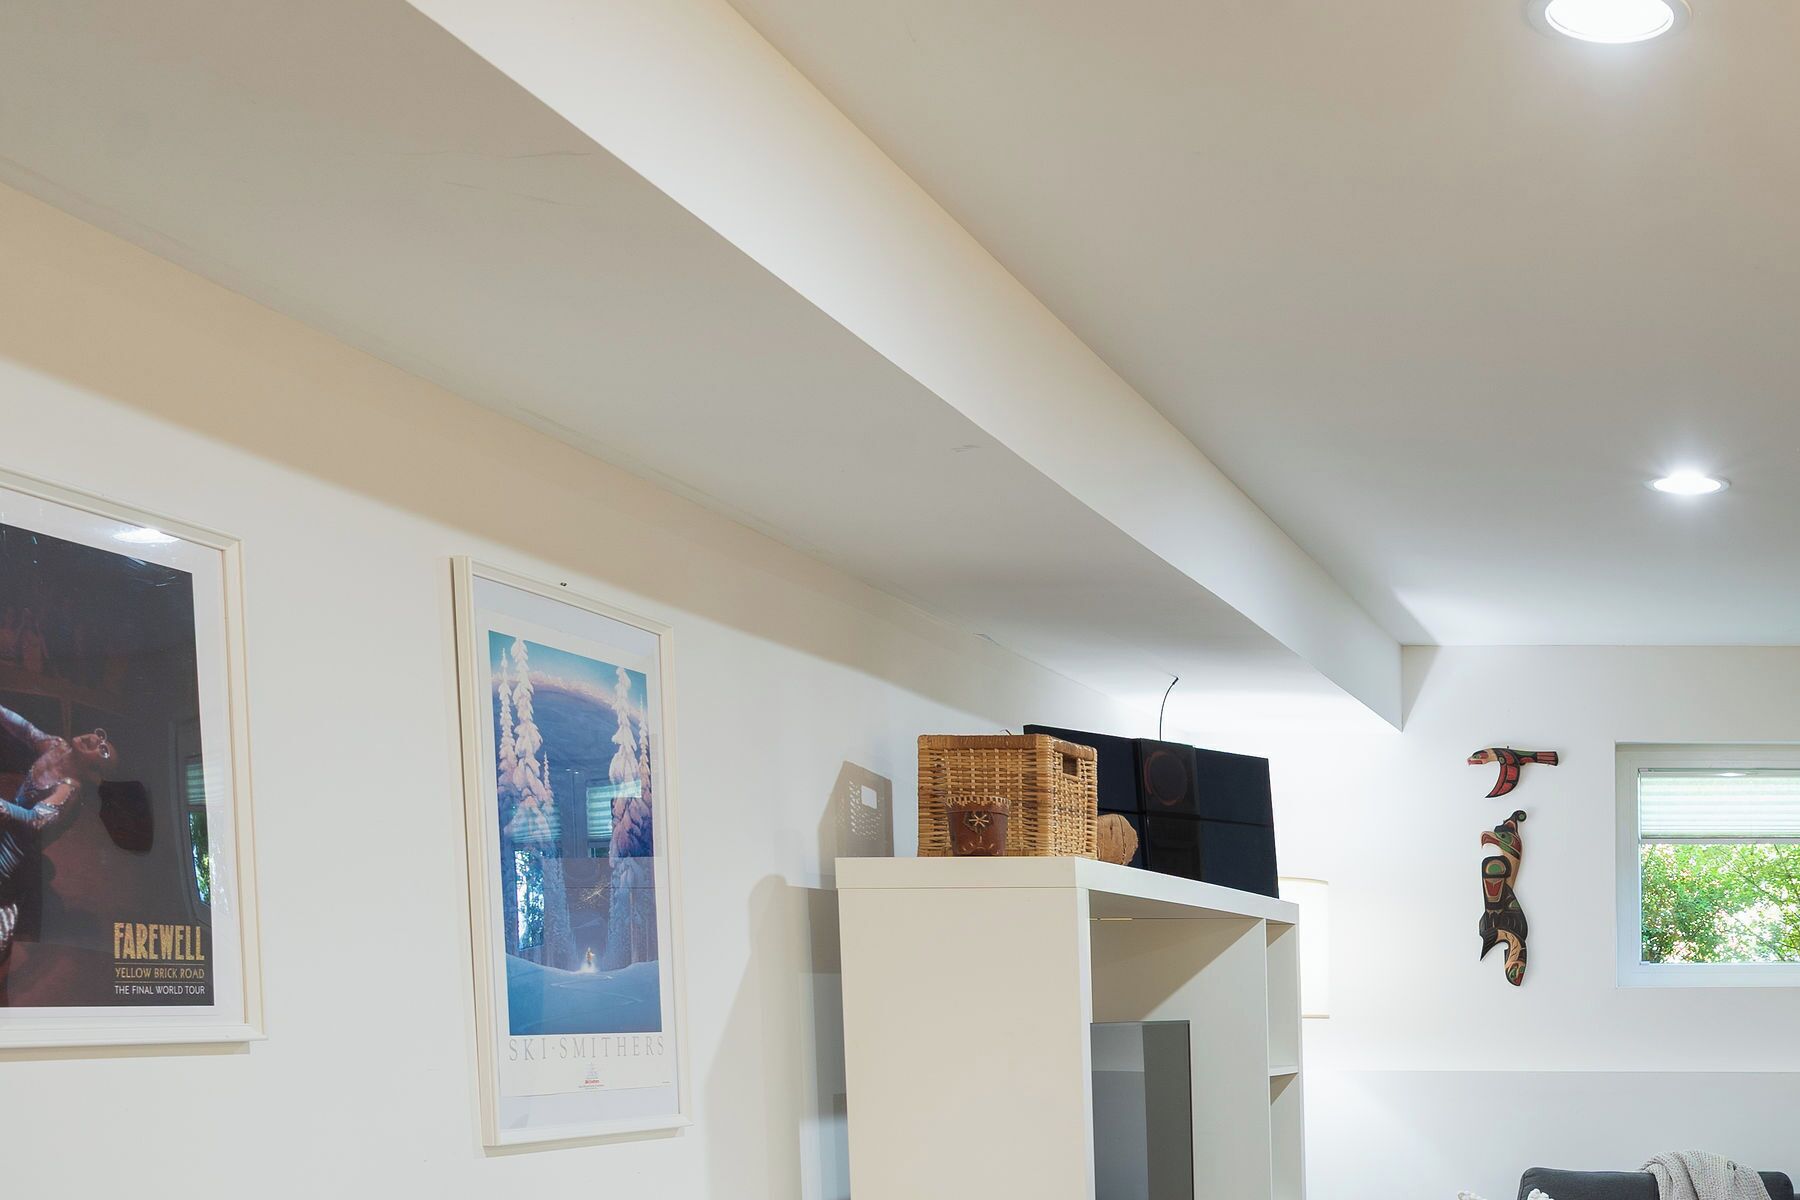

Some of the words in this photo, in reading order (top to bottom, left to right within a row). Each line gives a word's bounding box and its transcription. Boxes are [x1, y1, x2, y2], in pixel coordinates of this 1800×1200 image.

[114, 922, 205, 960] FAREWELL
[115, 968, 152, 978] YELLOW
[154, 968, 178, 978] BRICK
[180, 968, 205, 979] ROAD
[115, 985, 129, 994] THE
[132, 985, 154, 994] FINAL
[156, 985, 183, 994] WORLD
[185, 985, 205, 994] TOUR
[509, 1038, 547, 1061] SKI
[559, 1036, 665, 1059] SMITHERS
